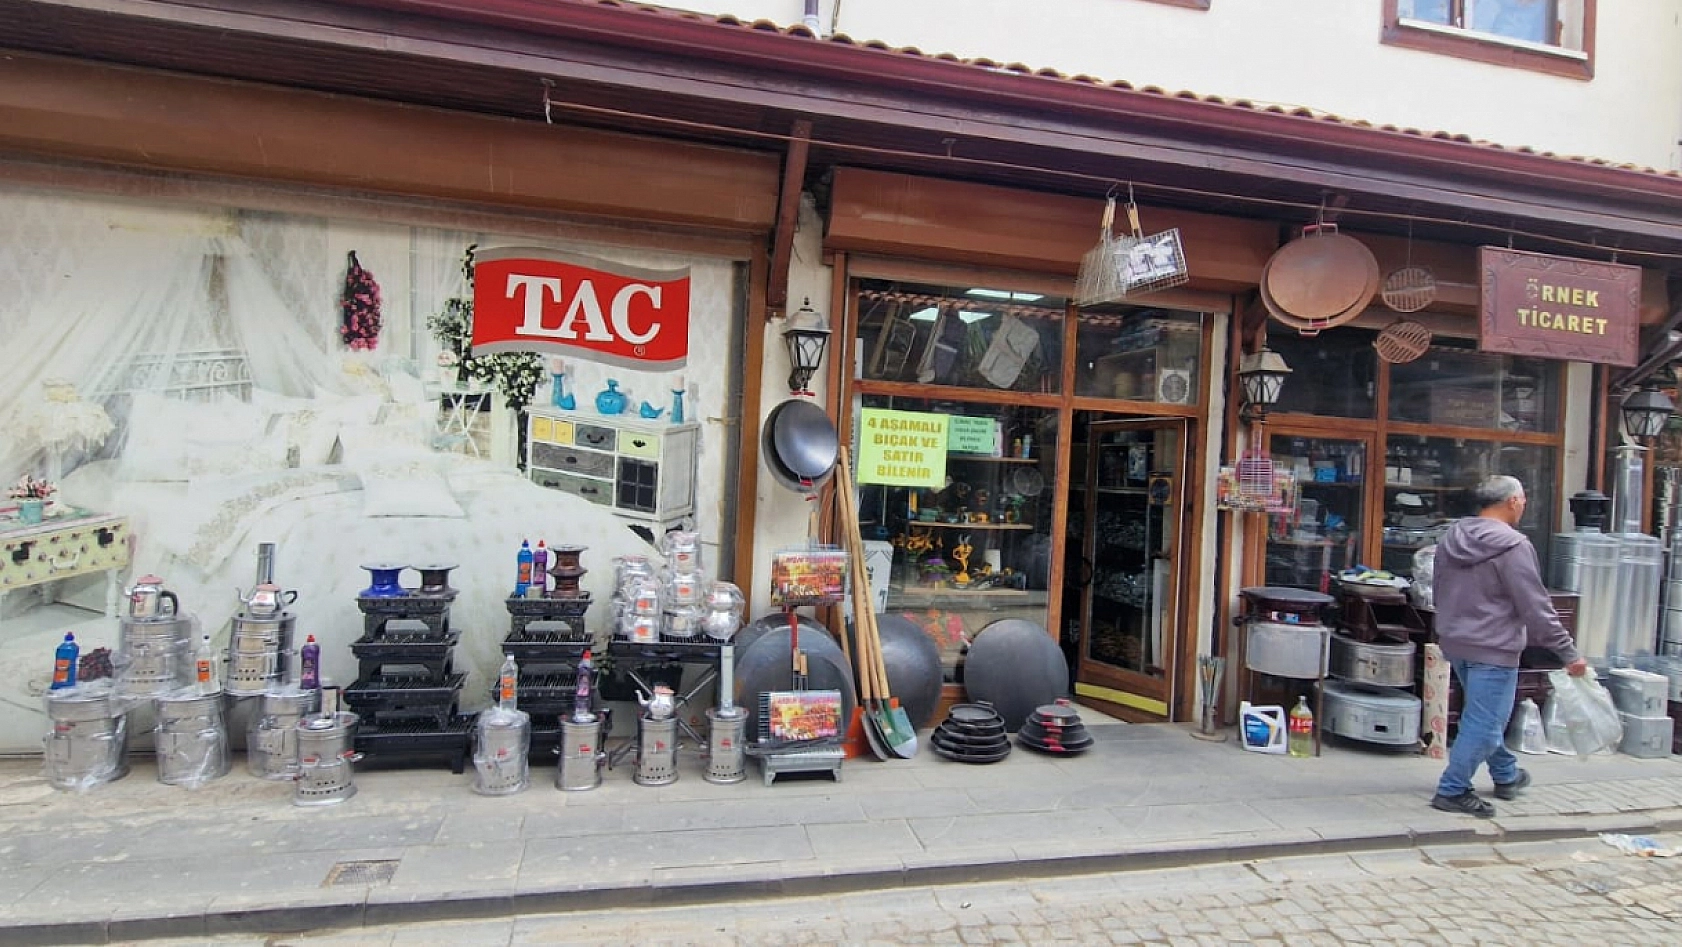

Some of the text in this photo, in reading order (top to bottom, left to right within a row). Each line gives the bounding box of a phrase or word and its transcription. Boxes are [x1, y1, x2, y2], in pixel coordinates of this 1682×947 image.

[1526, 278, 1599, 307] ÖRNEK
[506, 273, 662, 345] TAC
[1517, 305, 1608, 335] TİCARET
[867, 417, 877, 428] 4
[921, 437, 939, 448] VE
[883, 450, 924, 463] SATIR
